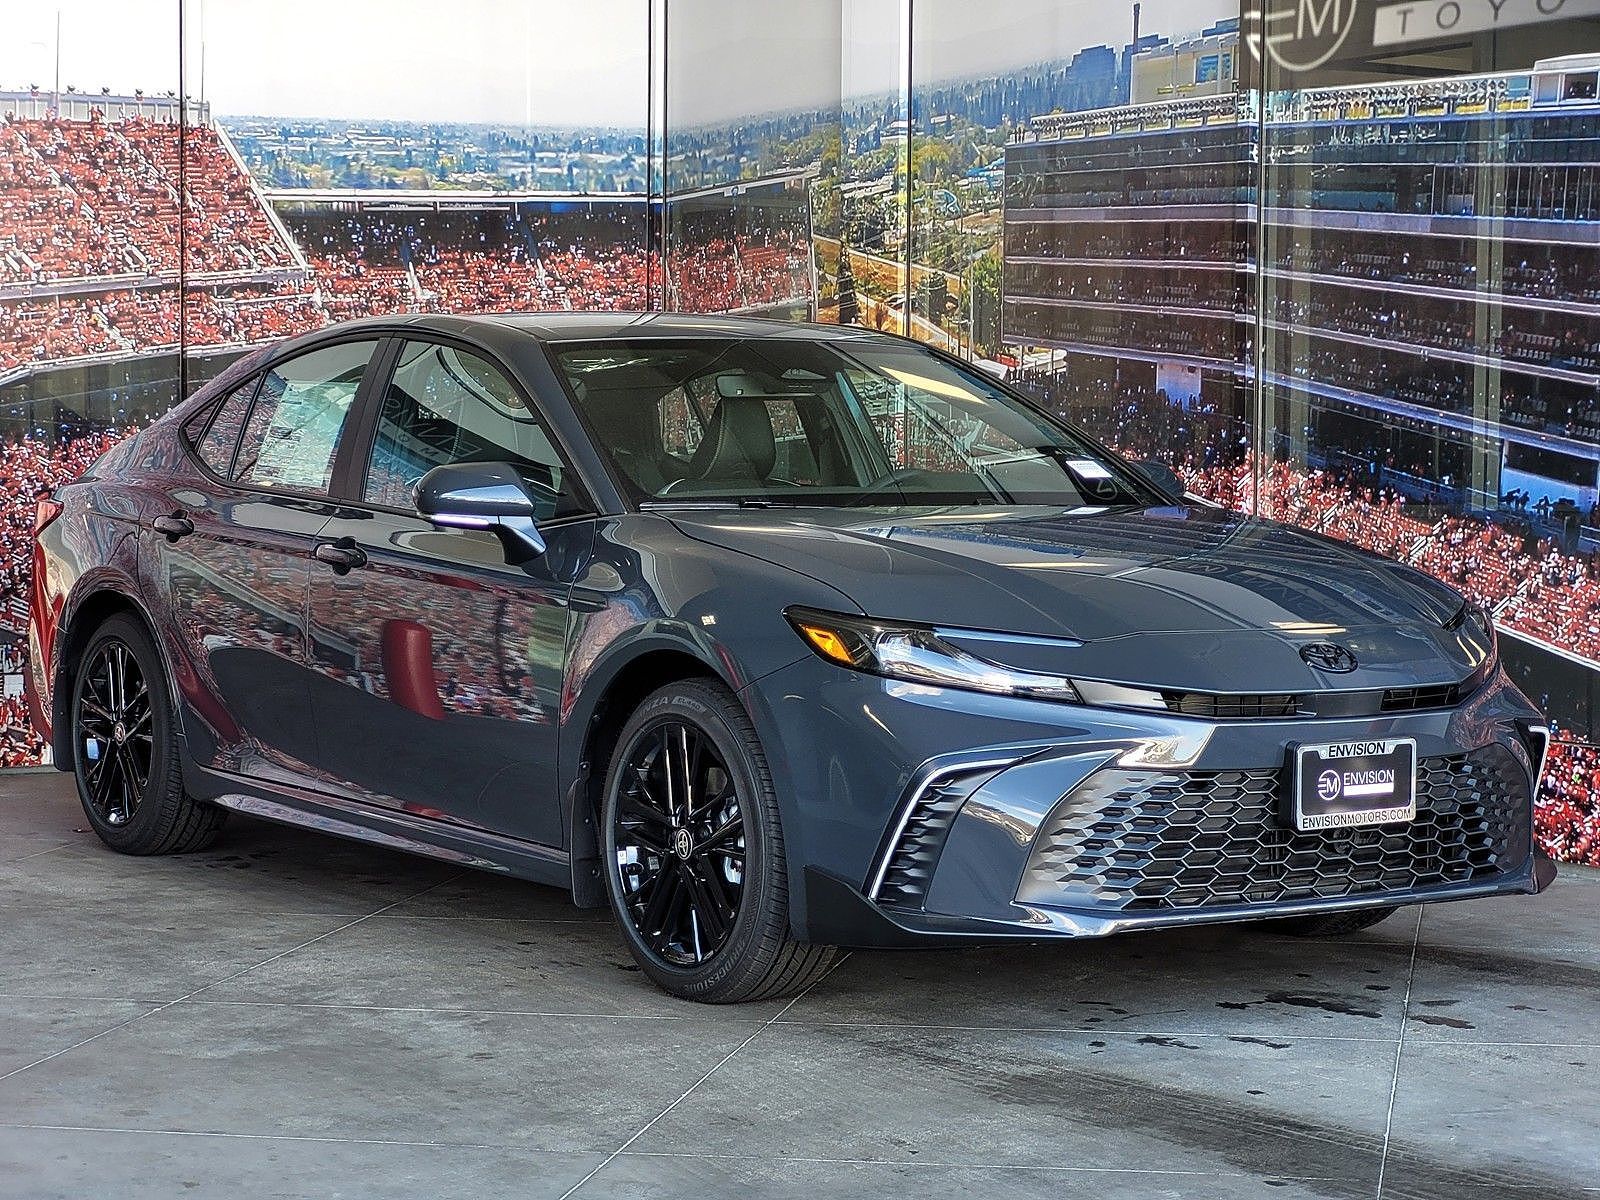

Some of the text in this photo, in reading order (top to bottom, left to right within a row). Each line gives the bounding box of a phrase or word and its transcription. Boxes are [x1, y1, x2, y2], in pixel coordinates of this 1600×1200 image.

[1328, 742, 1386, 757] ENVISION
[1343, 769, 1395, 785] ENVISION
[1302, 808, 1411, 829] ENVISIONMOTORS.COM
